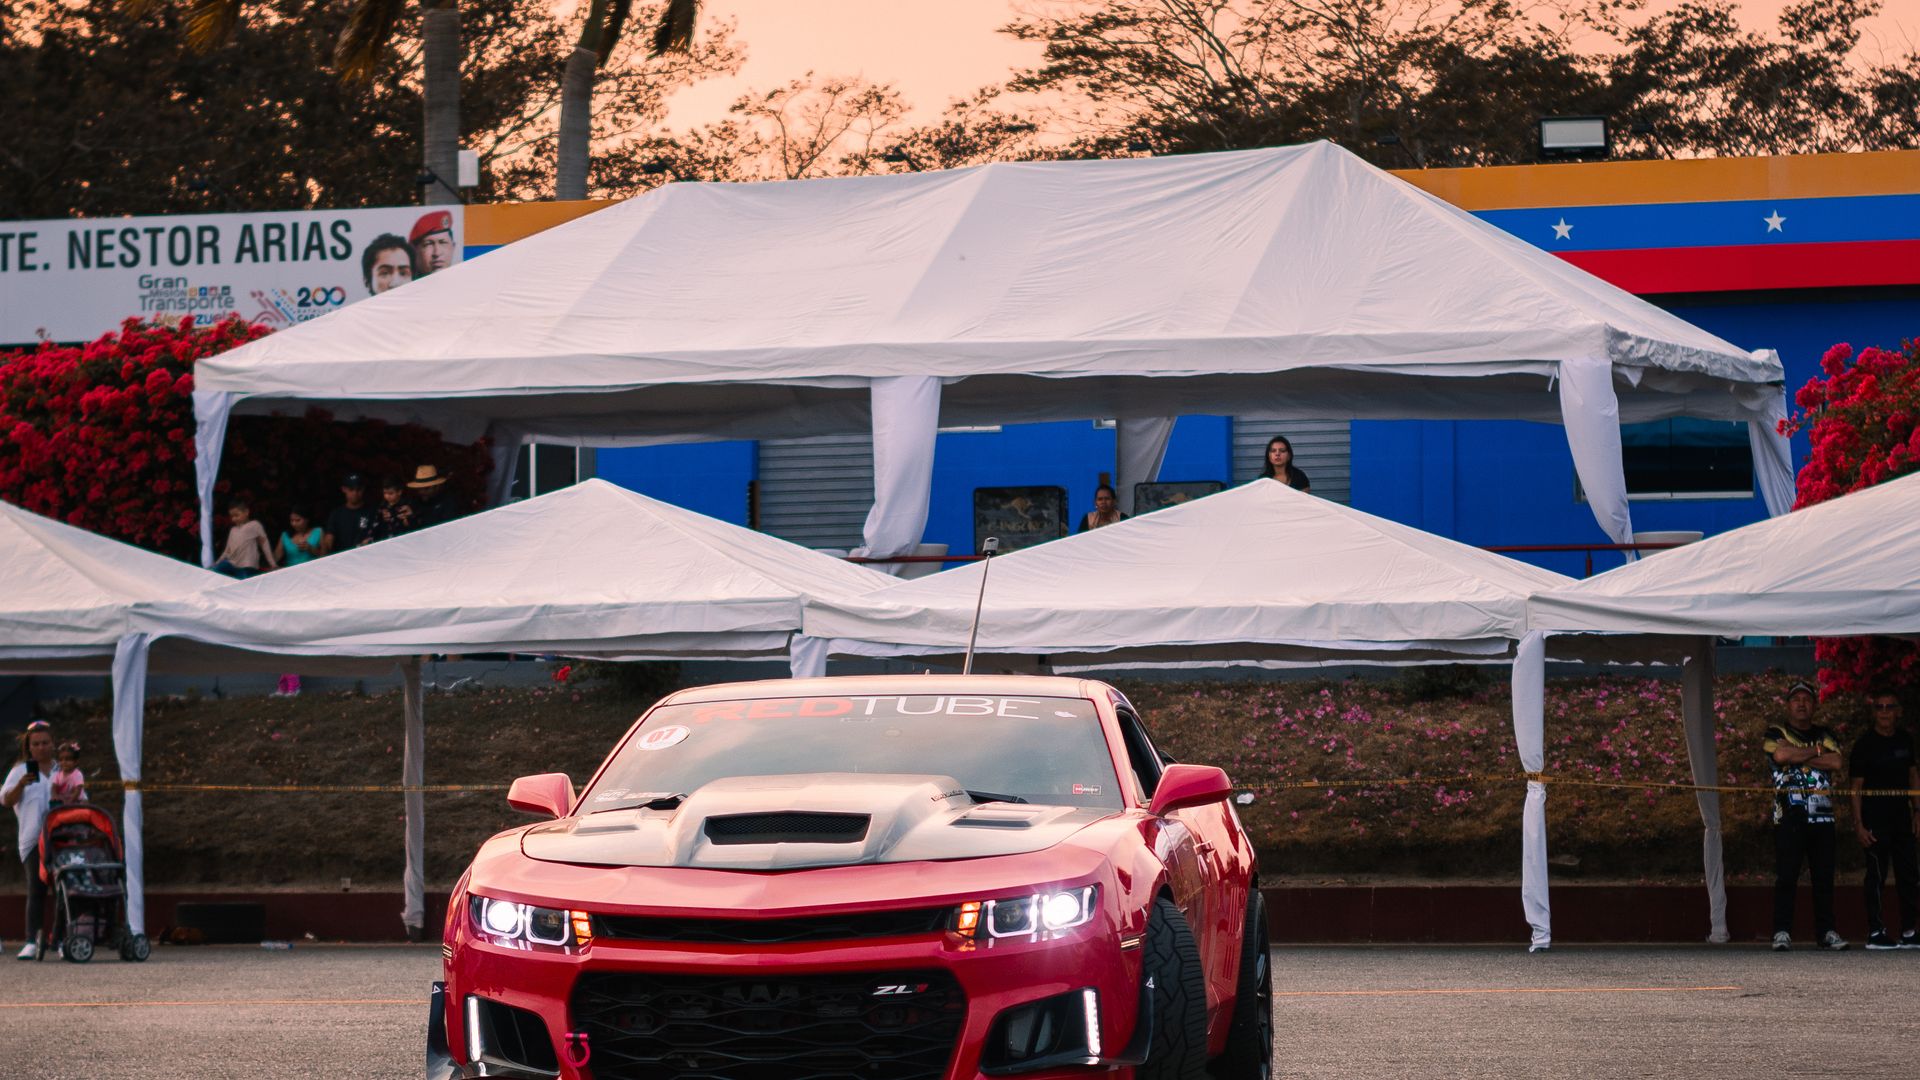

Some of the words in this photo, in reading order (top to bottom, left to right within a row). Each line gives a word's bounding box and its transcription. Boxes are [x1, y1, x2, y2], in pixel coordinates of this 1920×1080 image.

[68, 225, 220, 269] NESTOR
[234, 219, 352, 264] ARIAS
[138, 274, 188, 289] Gran
[138, 293, 235, 313] Transporte
[297, 286, 346, 308] 200
[691, 696, 1041, 723] REDTUBE
[646, 727, 680, 744] 07
